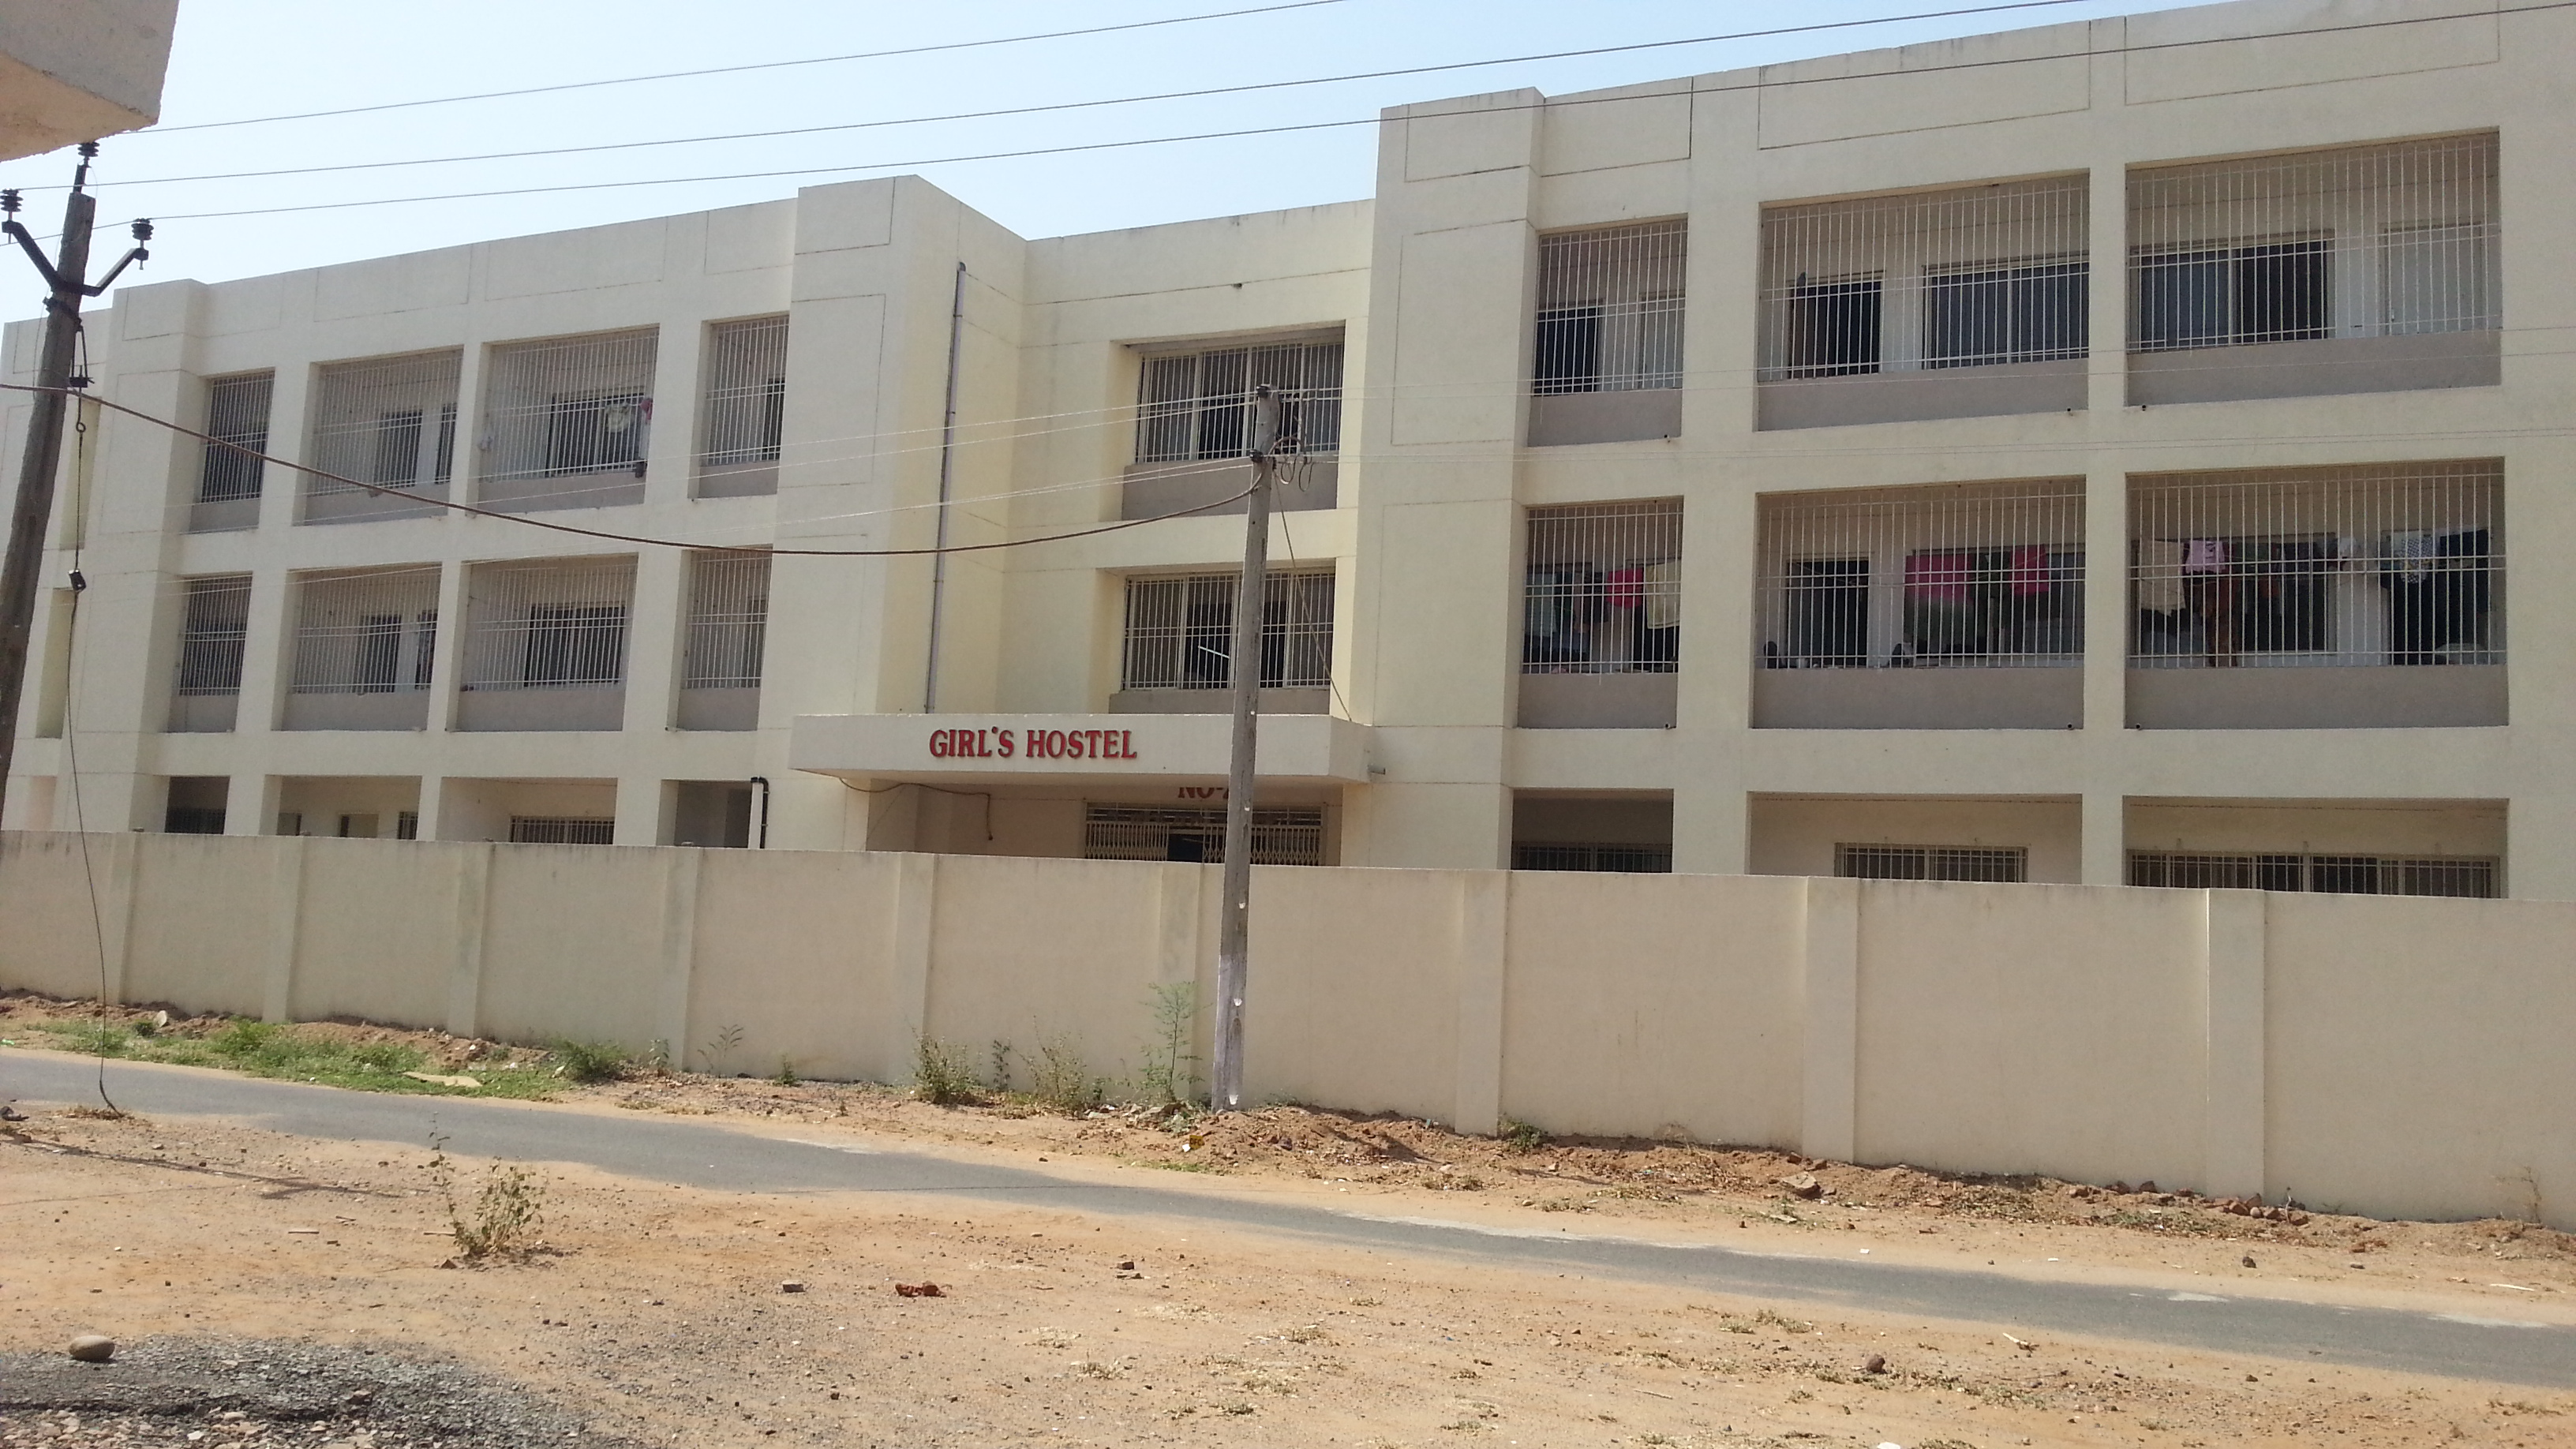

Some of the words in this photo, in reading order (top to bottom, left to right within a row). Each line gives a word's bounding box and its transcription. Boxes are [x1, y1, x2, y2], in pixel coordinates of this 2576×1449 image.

[929, 726, 1014, 758] GIRL'S
[1026, 728, 1137, 758] HOSTEL
[1178, 787, 1230, 799] NO-
